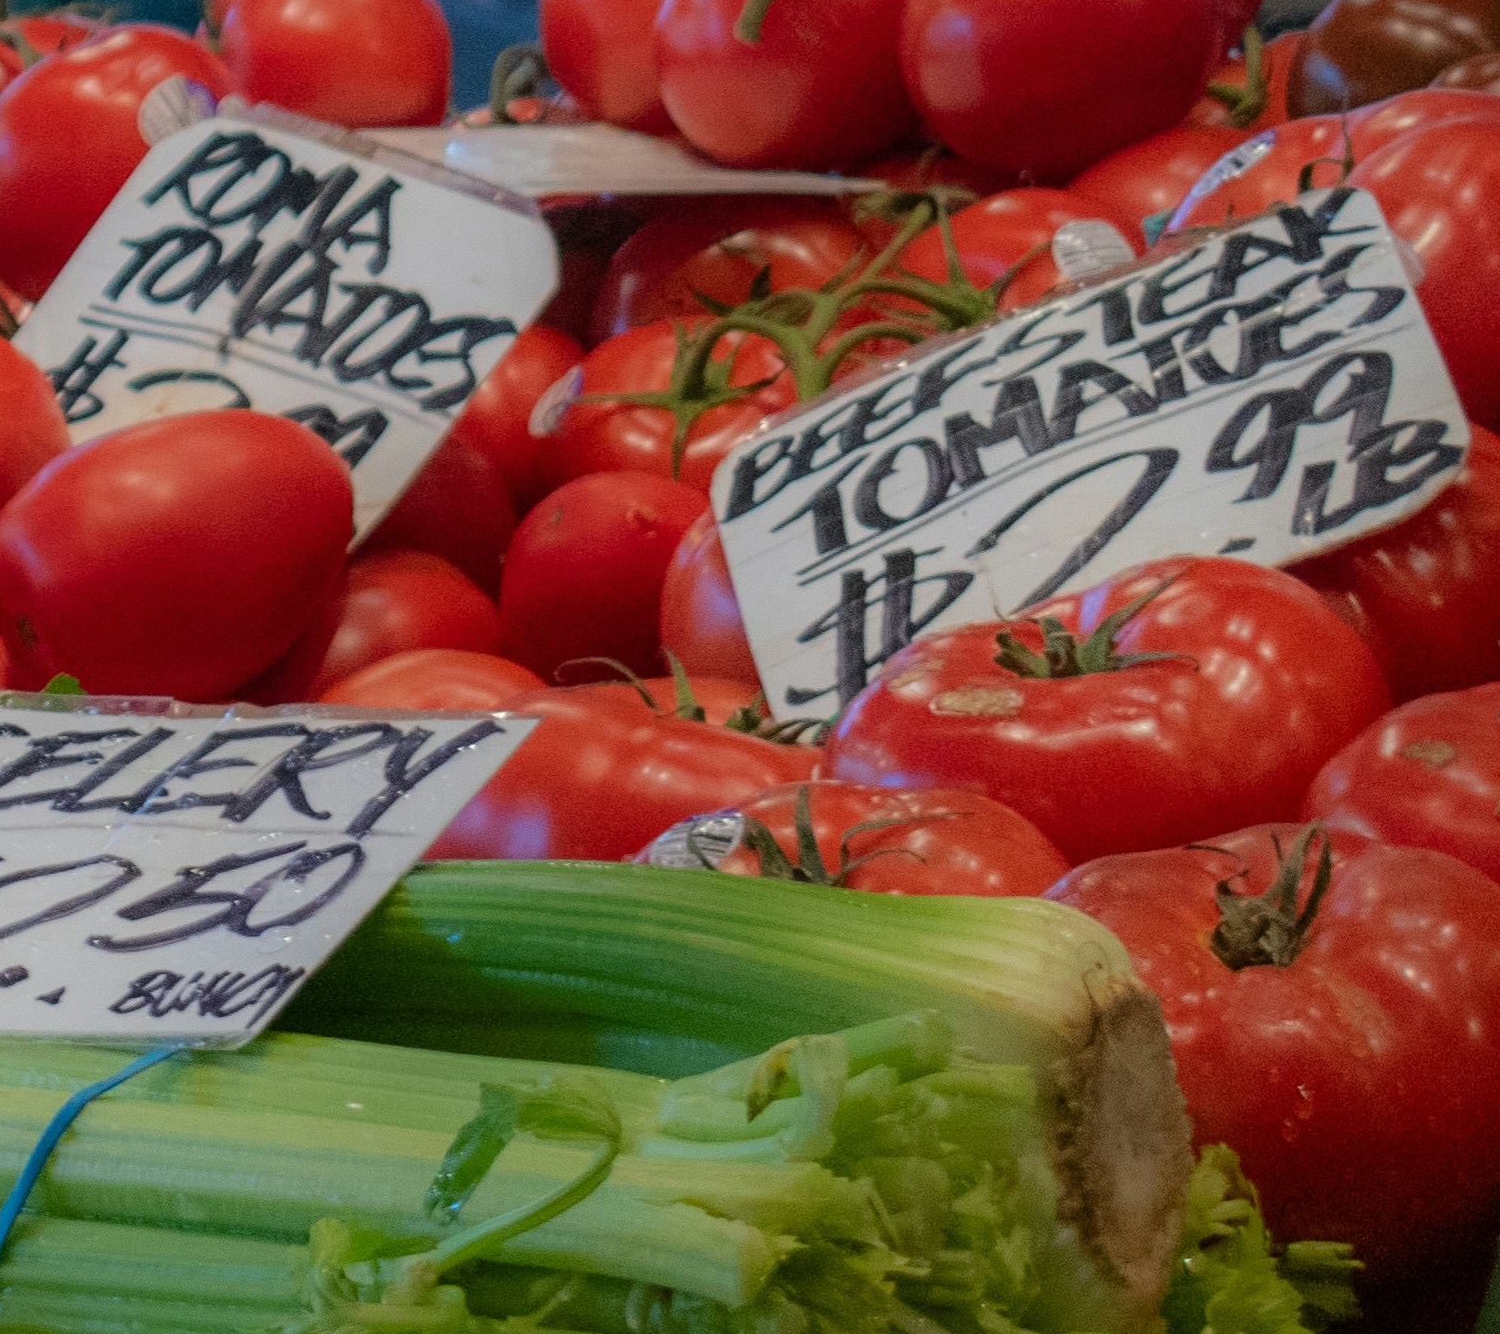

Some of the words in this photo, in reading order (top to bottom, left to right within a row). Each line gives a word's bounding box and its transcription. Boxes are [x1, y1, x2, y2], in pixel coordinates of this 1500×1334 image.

[141, 130, 403, 276] ROMA
[724, 186, 1382, 525] BEEFSTEAK
[1291, 417, 1470, 539] LB
